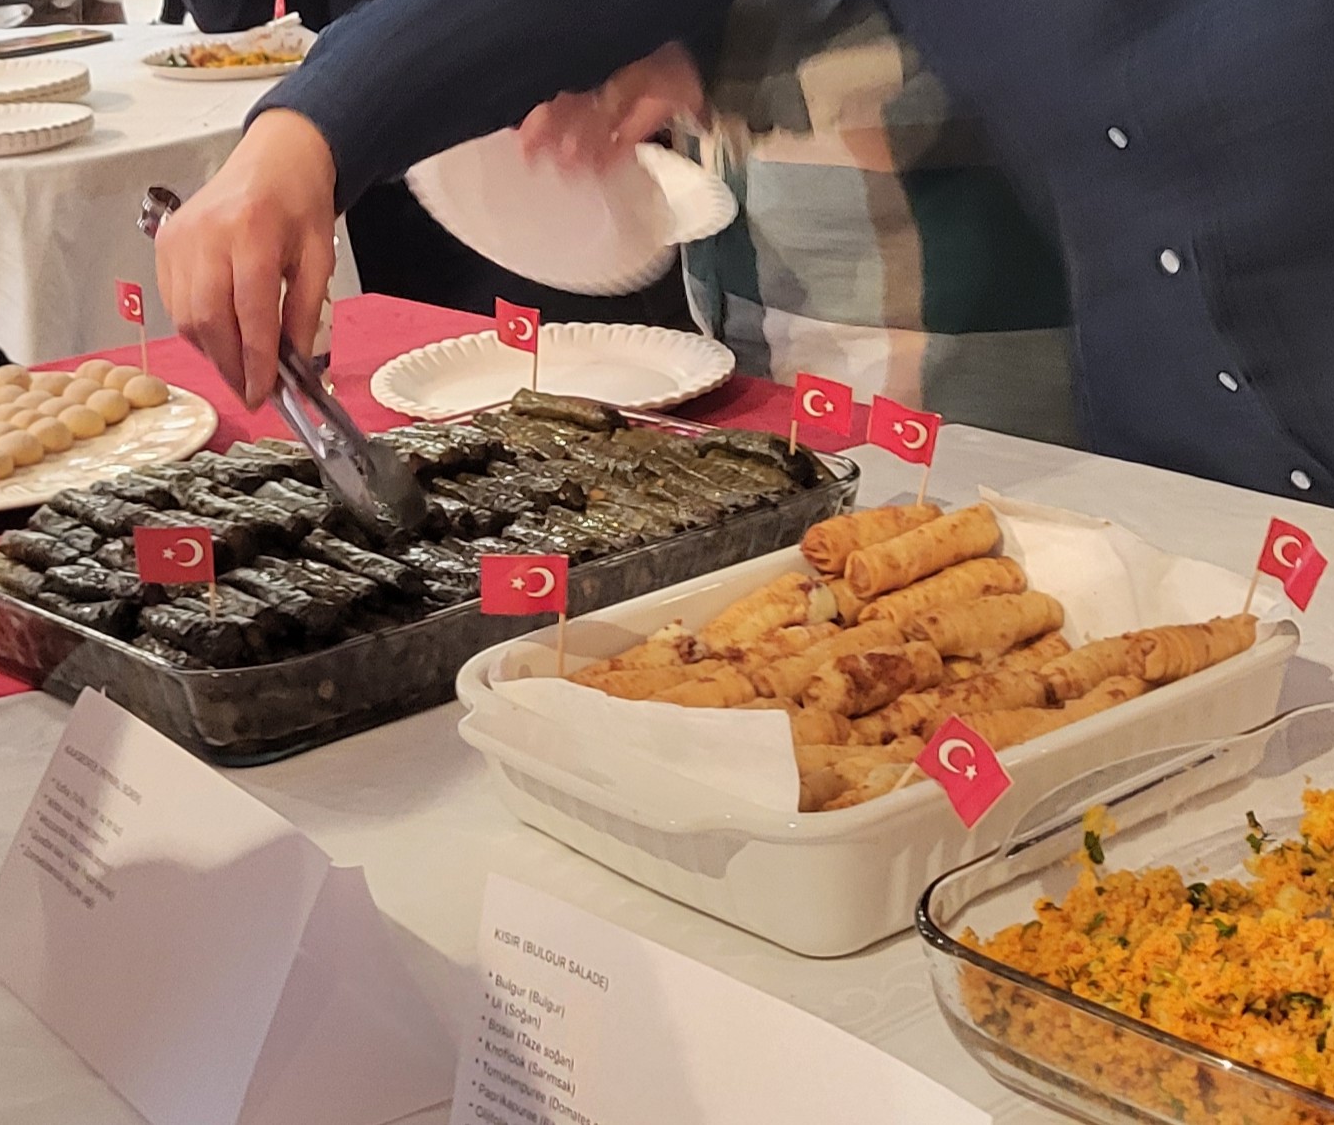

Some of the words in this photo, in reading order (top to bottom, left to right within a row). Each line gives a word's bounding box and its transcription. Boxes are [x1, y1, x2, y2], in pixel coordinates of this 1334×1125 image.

[494, 928, 520, 949] KISIR
[522, 940, 566, 970] (BULGUR
[568, 960, 609, 993] SALADE)
[495, 974, 526, 997] Bulgur
[529, 988, 565, 1019] (Bulgur)
[517, 1031, 542, 1054] (Taze
